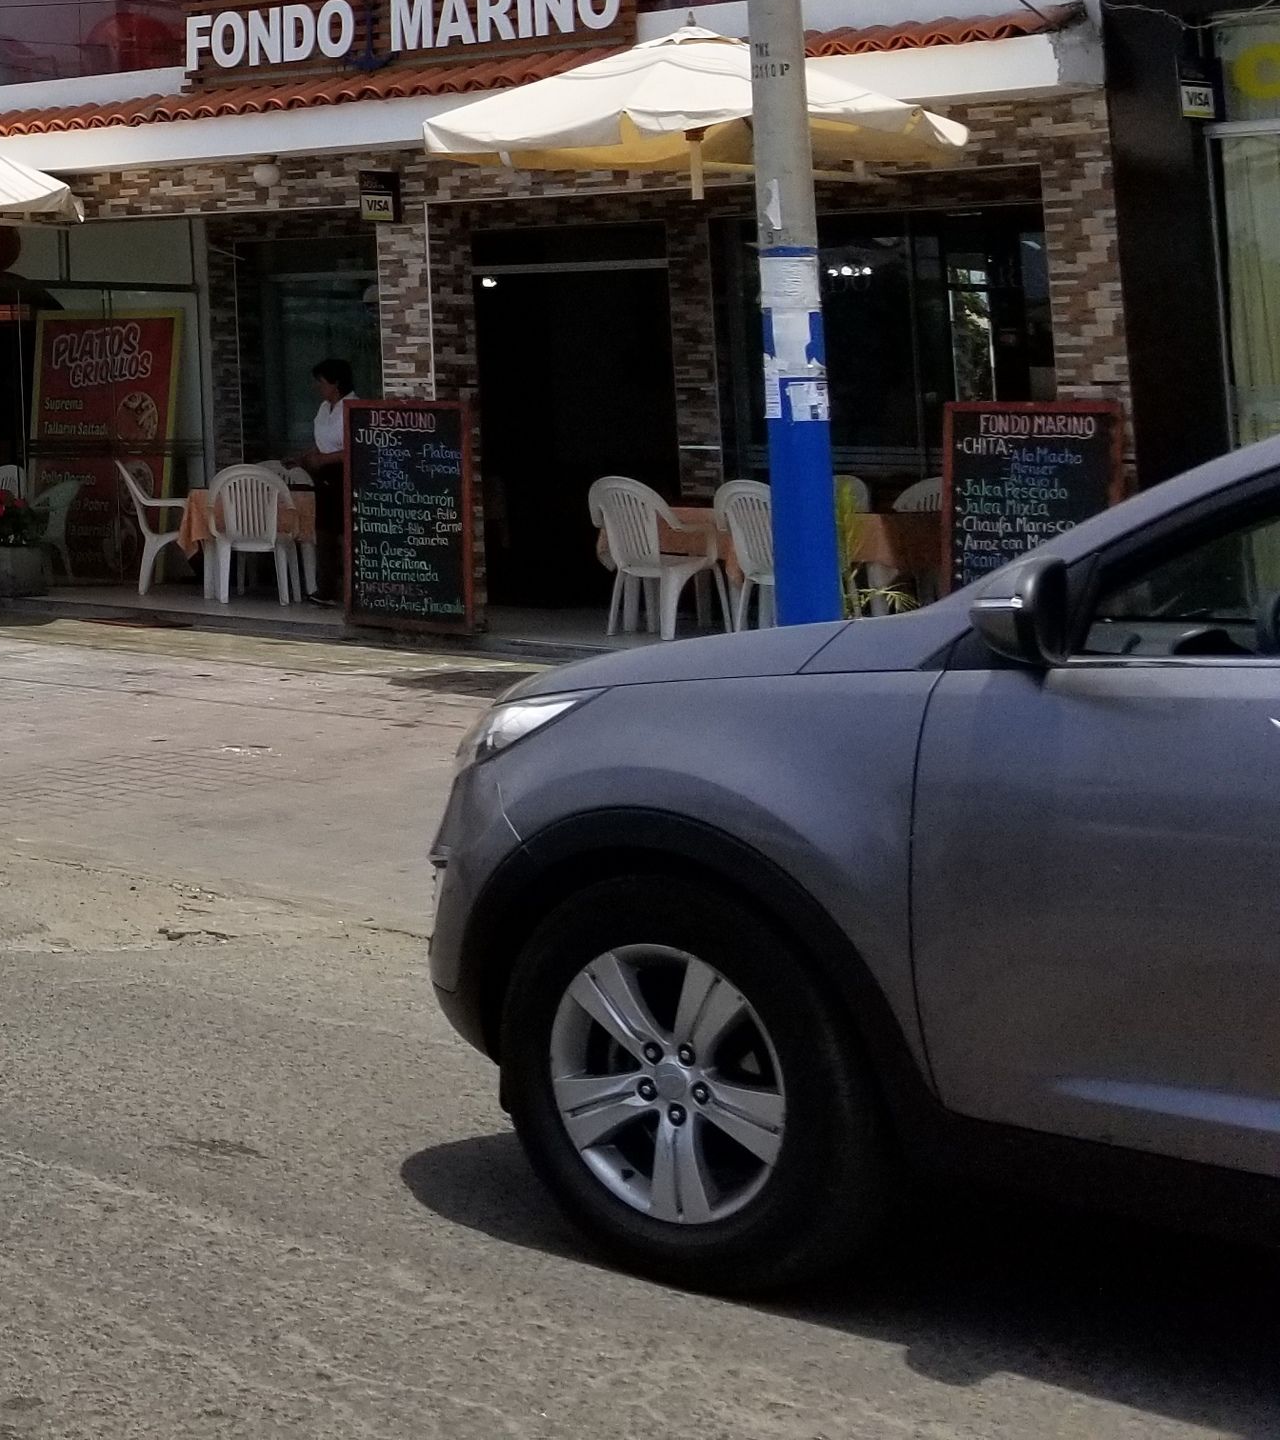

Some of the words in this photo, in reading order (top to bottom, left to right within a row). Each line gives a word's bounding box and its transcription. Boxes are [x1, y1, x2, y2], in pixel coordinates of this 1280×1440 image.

[1186, 91, 1210, 107] VISA
[366, 199, 389, 211] VISA
[52, 322, 140, 370] PLATOS
[70, 350, 153, 388] CRIOLLOS
[369, 410, 437, 430] DESAYUNO
[980, 414, 1030, 434] FONDO
[1033, 415, 1096, 435] MARINO
[1005, 479, 1068, 500] Pescado
[358, 502, 432, 524] Hamburguesa
[359, 517, 403, 535] Tamales
[380, 541, 417, 557] Queso
